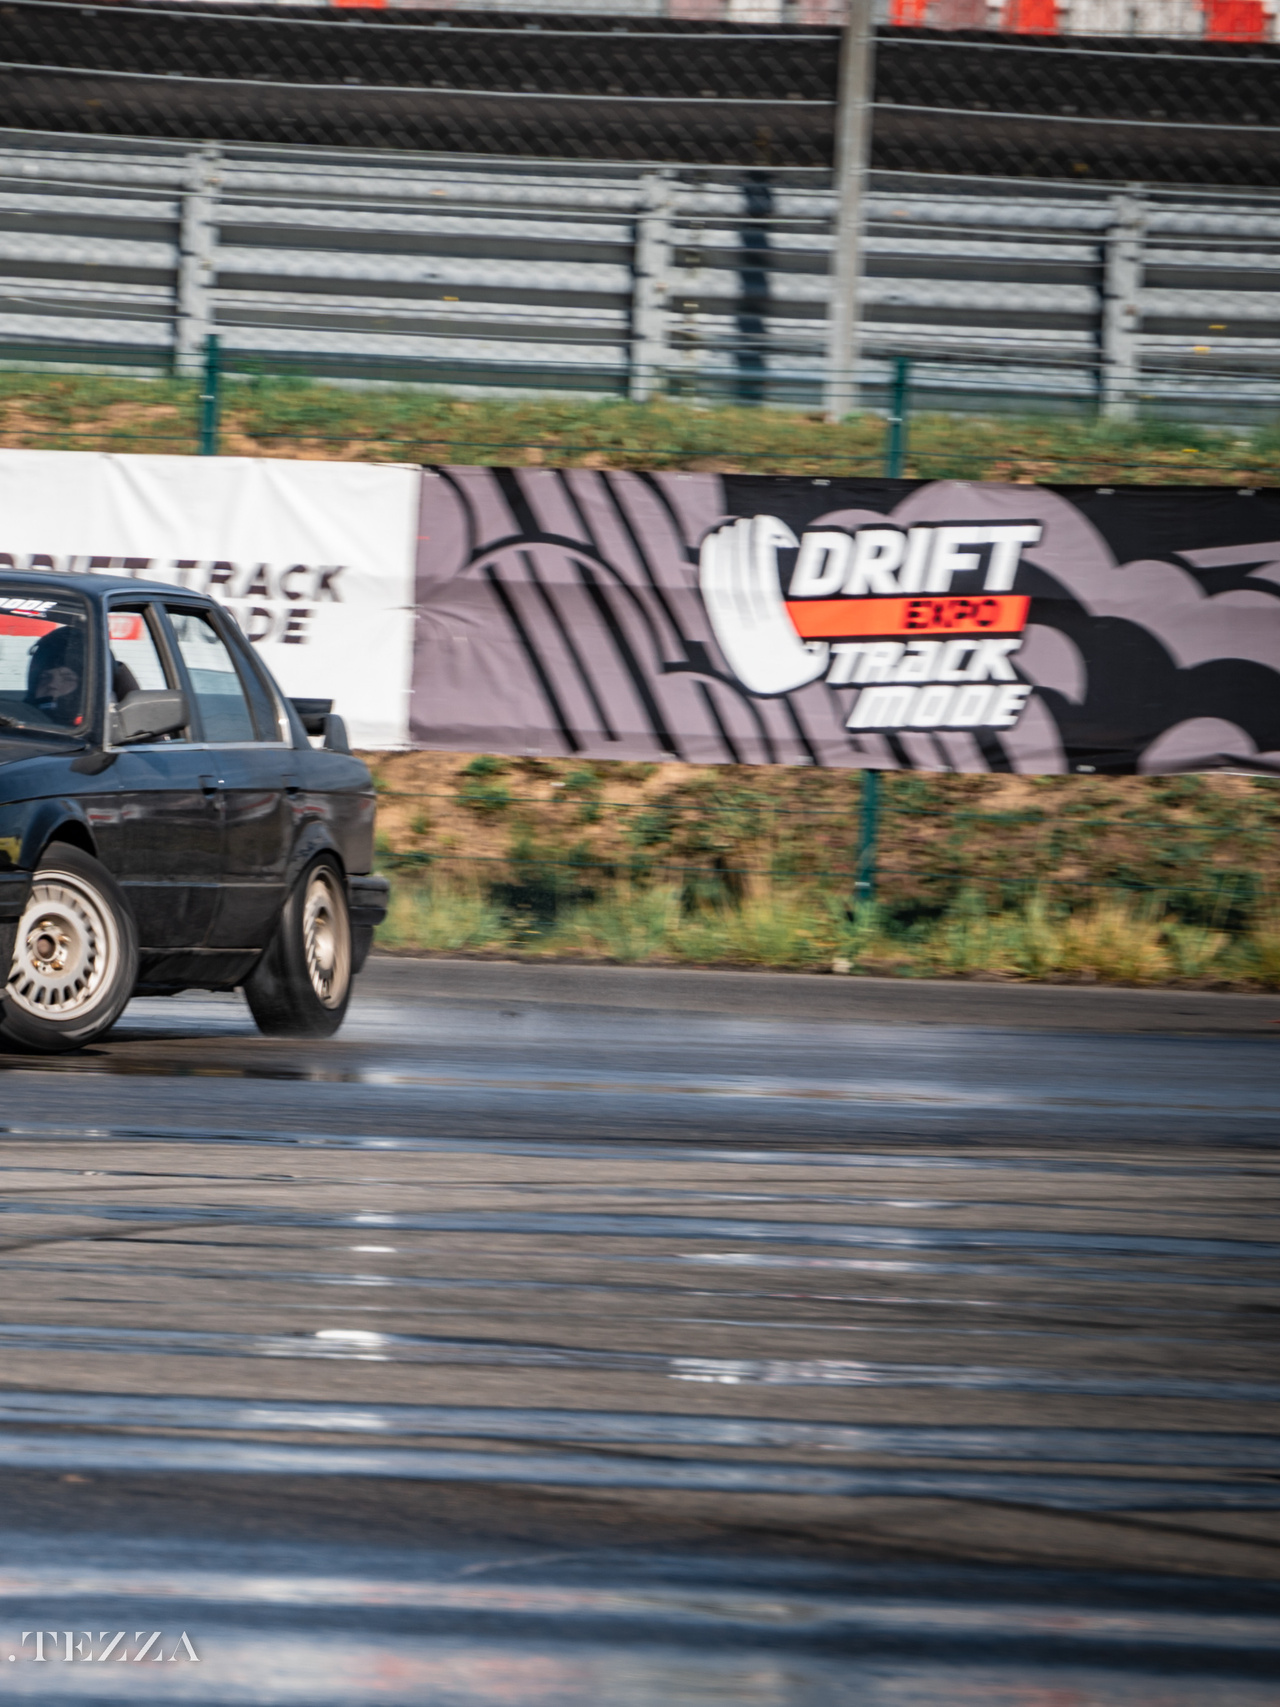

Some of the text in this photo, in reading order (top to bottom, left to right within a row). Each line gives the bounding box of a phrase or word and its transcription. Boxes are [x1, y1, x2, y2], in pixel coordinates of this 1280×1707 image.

[175, 559, 347, 602] TRACK
[788, 525, 1043, 596] DRIFT
[192, 606, 314, 644] DE
[905, 599, 1000, 630] EXPO
[825, 638, 1024, 685] TRACK
[845, 684, 1033, 729] MODE
